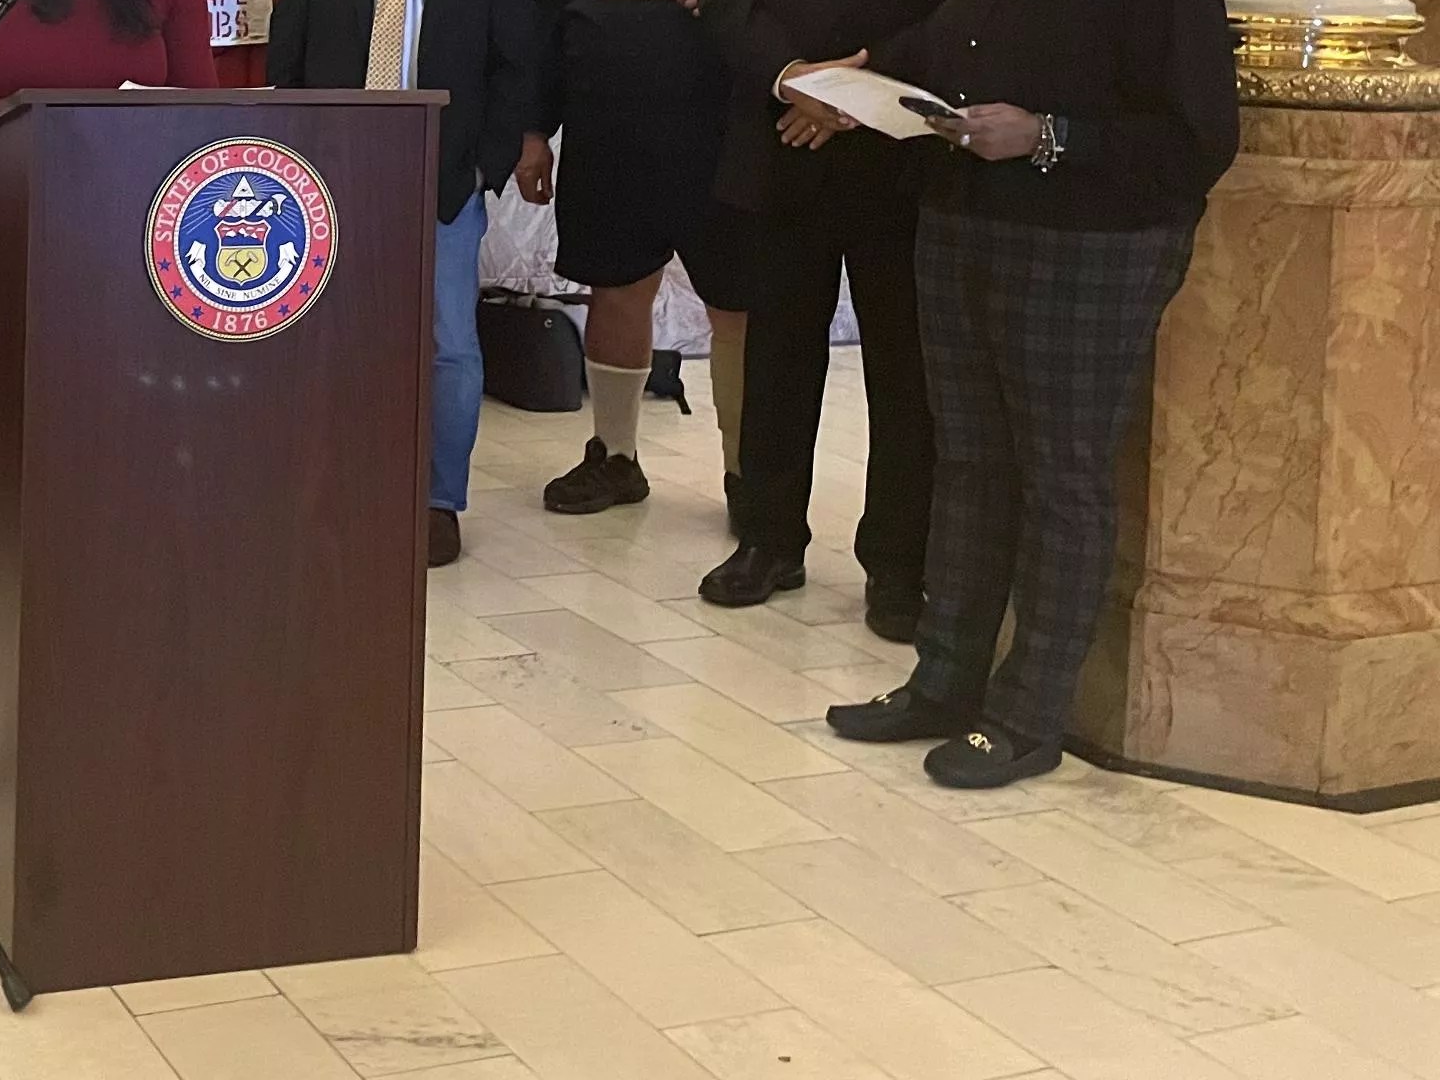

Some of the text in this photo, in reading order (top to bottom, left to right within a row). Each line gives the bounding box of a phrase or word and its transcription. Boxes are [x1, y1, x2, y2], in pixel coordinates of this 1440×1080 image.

[211, 10, 250, 39] BS
[155, 147, 329, 242] STATE OF COLORADO
[216, 287, 237, 300] SINE
[243, 276, 282, 300] NUMINE
[212, 310, 268, 333] 1876
